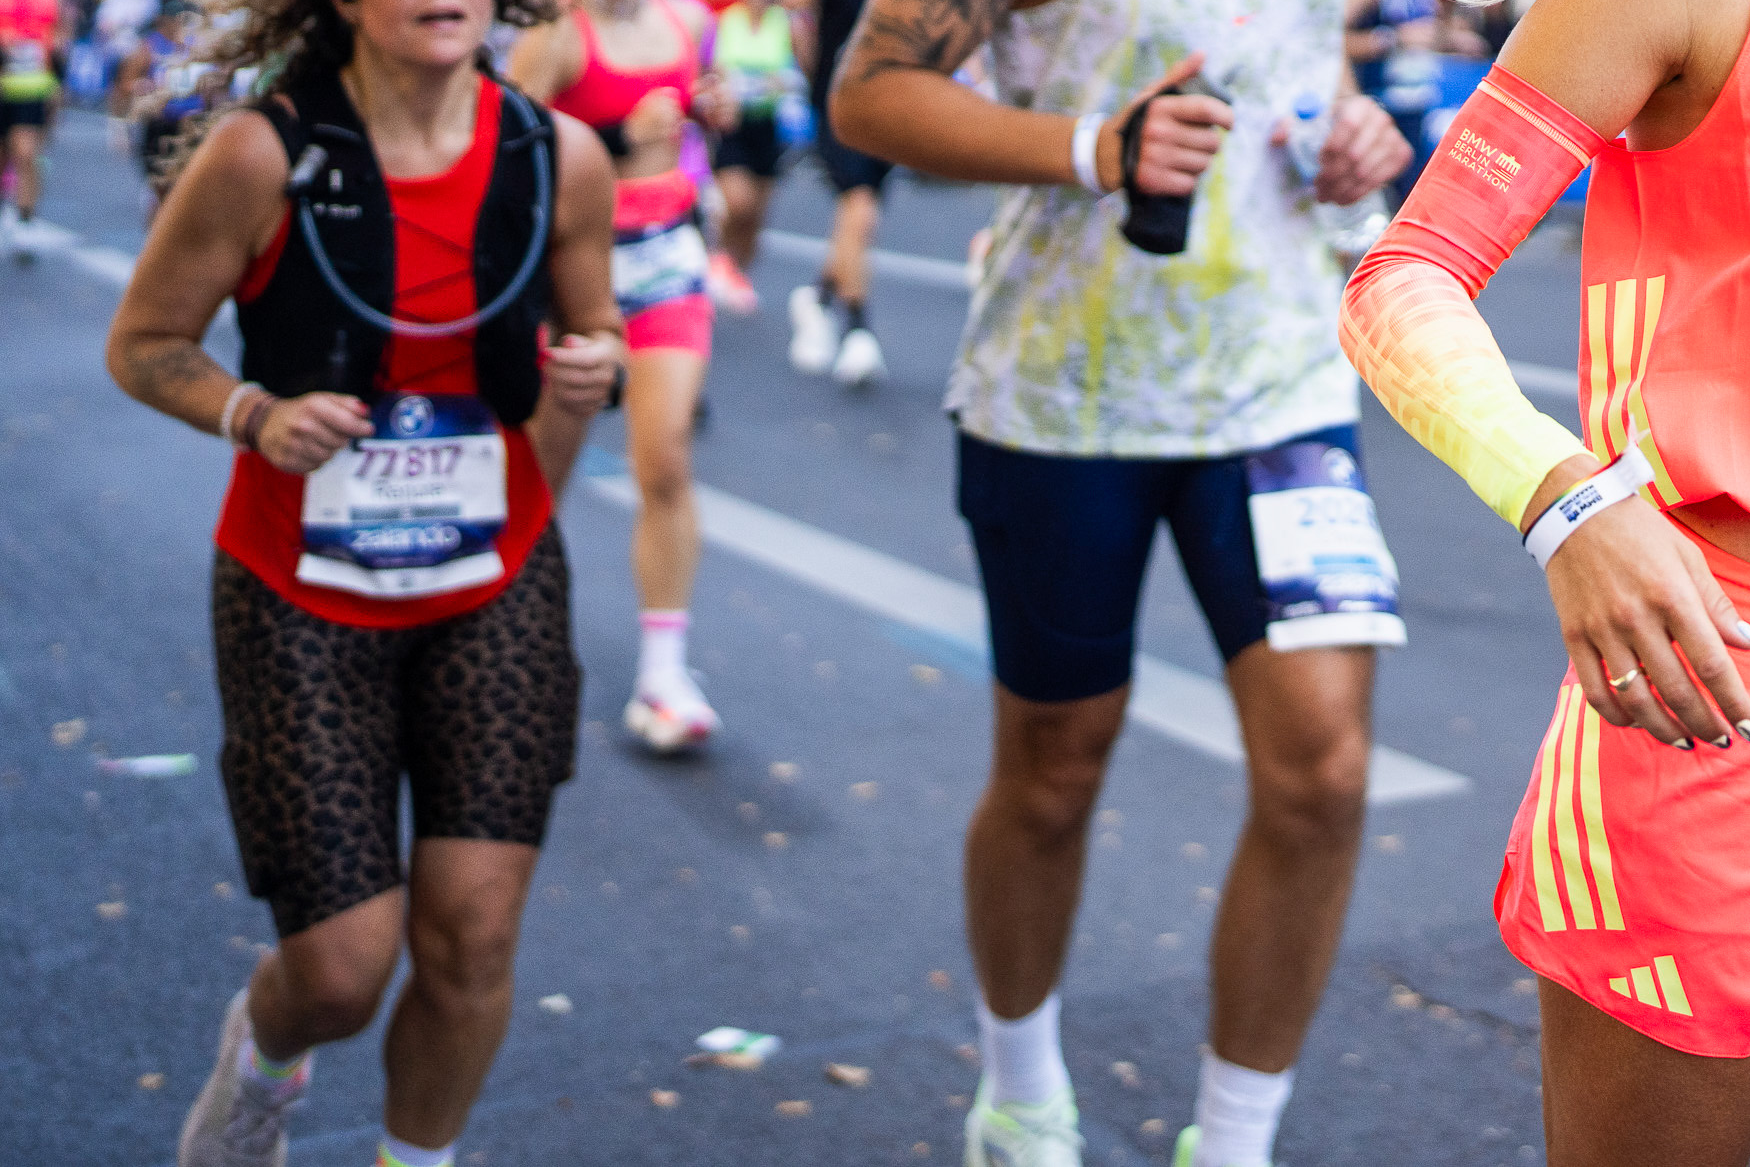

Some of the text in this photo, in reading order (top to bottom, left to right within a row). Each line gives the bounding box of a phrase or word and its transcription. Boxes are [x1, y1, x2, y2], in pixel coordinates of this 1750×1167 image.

[1454, 140, 1490, 167] BERLIN
[1460, 128, 1498, 157] BMW
[1448, 148, 1509, 193] MARATHON
